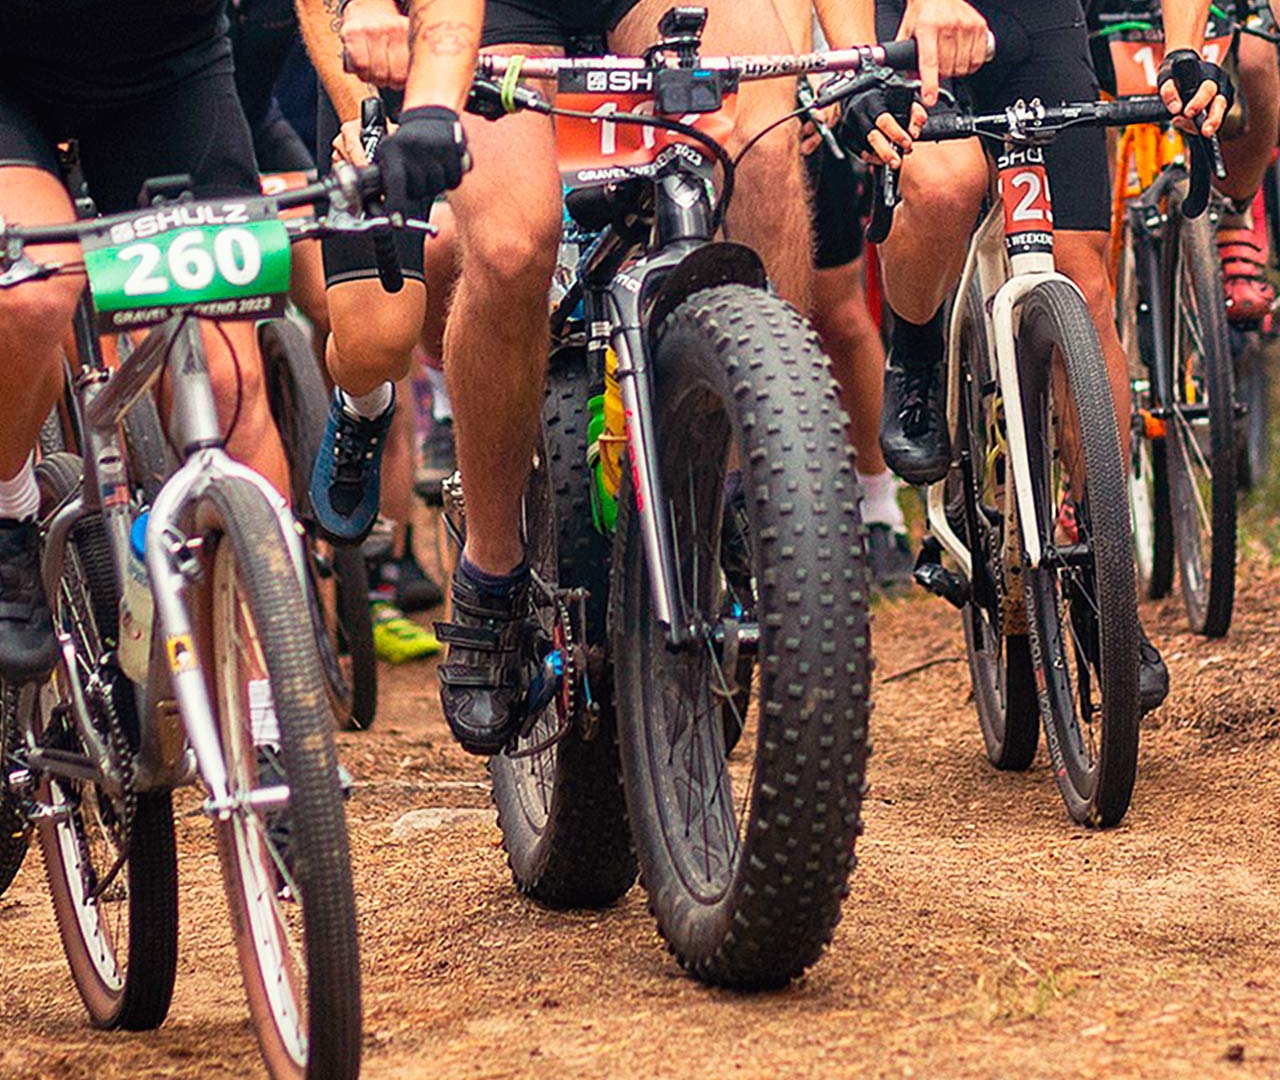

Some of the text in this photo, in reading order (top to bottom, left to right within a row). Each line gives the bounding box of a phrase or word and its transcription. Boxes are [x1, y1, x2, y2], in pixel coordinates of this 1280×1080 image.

[578, 164, 629, 182] GRAVEL
[133, 204, 249, 238] SHULZ
[117, 227, 262, 296] 260
[113, 308, 168, 326] GRAVEL
